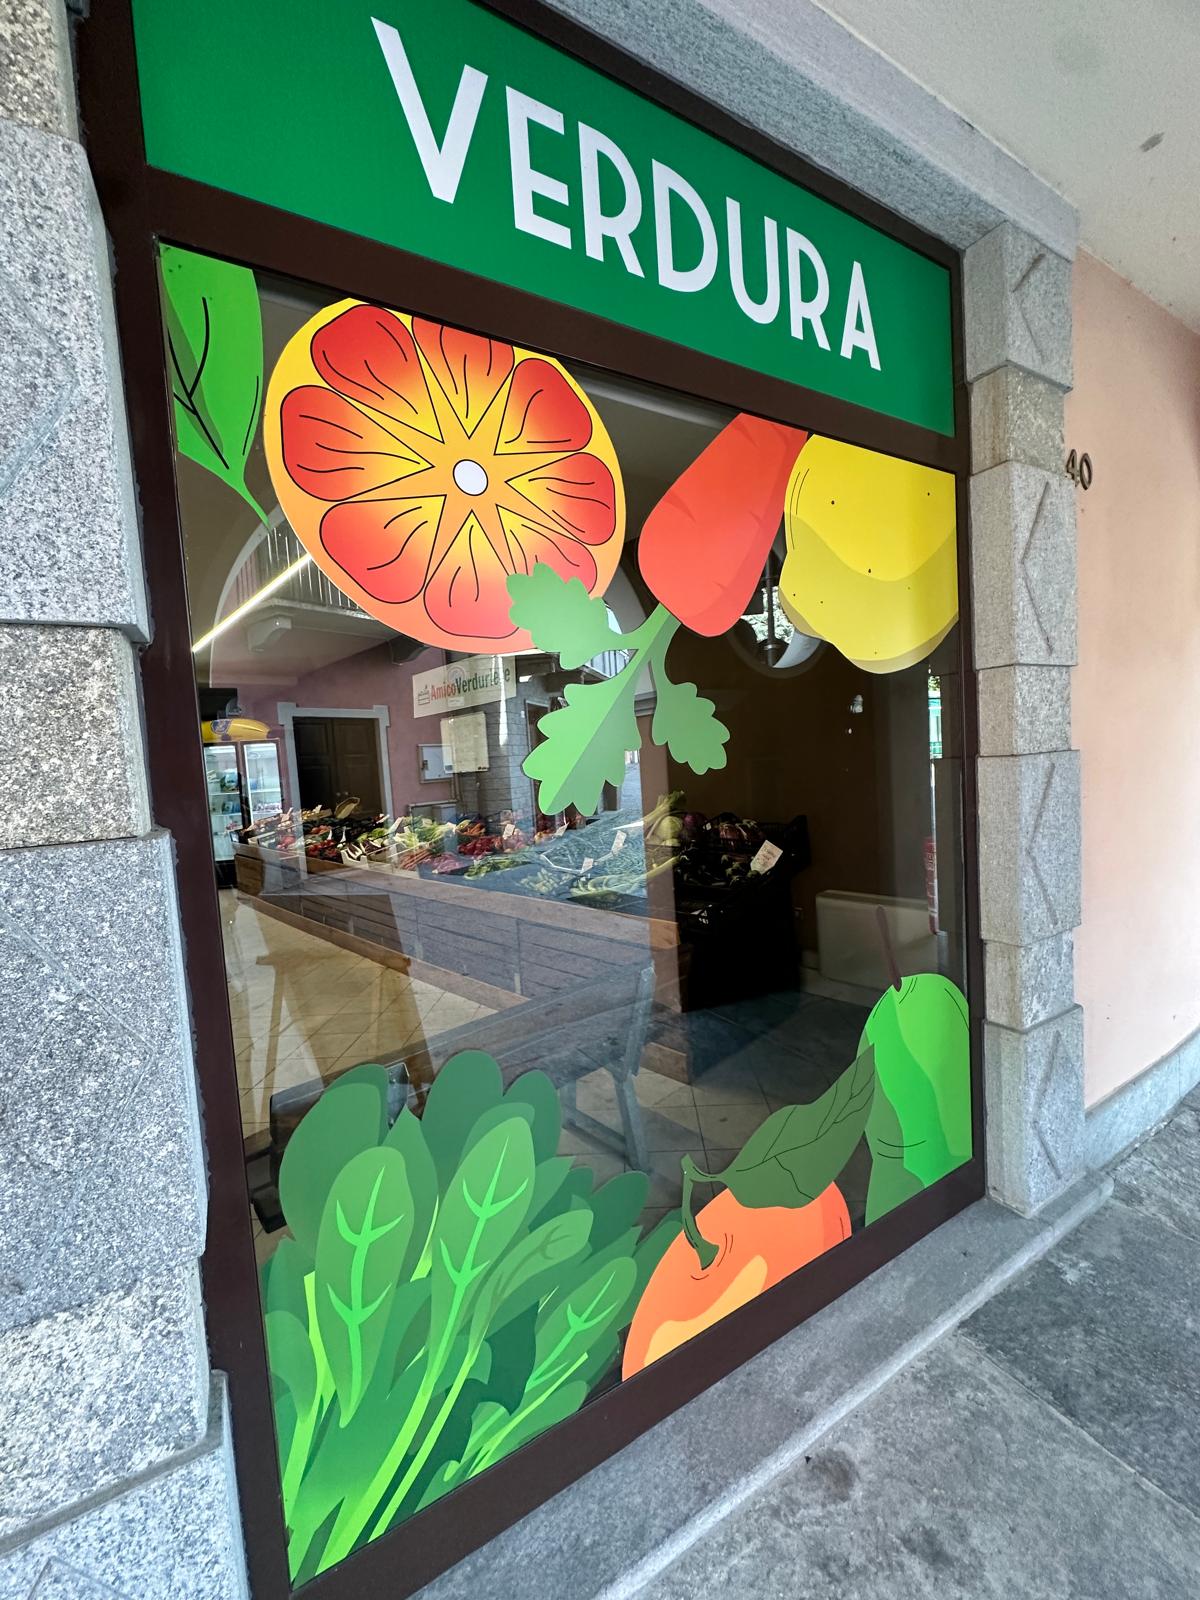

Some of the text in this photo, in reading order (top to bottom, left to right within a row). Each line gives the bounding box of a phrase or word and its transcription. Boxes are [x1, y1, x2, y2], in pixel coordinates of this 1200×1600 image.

[371, 17, 882, 370] VERDURA
[1065, 449, 1093, 490] 40
[431, 668, 510, 701] AmicoVerduriee
